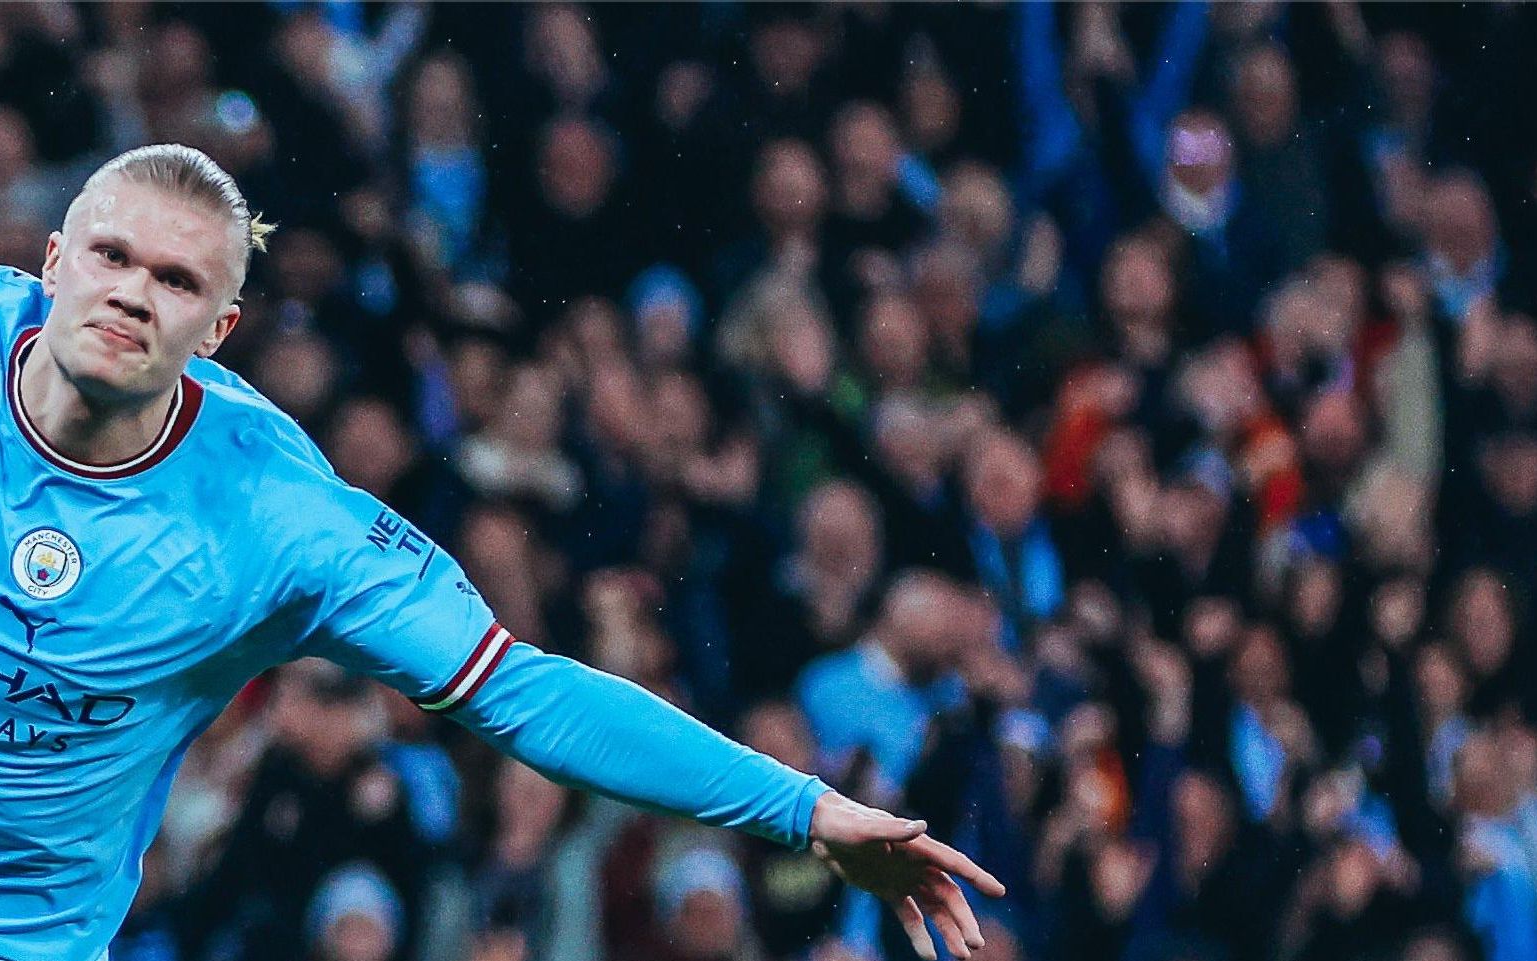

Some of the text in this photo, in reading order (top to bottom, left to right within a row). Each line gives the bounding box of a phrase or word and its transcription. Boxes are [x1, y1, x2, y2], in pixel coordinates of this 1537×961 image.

[365, 508, 402, 553] NE
[24, 532, 78, 565] MANCHESTER
[27, 585, 49, 597] CITY
